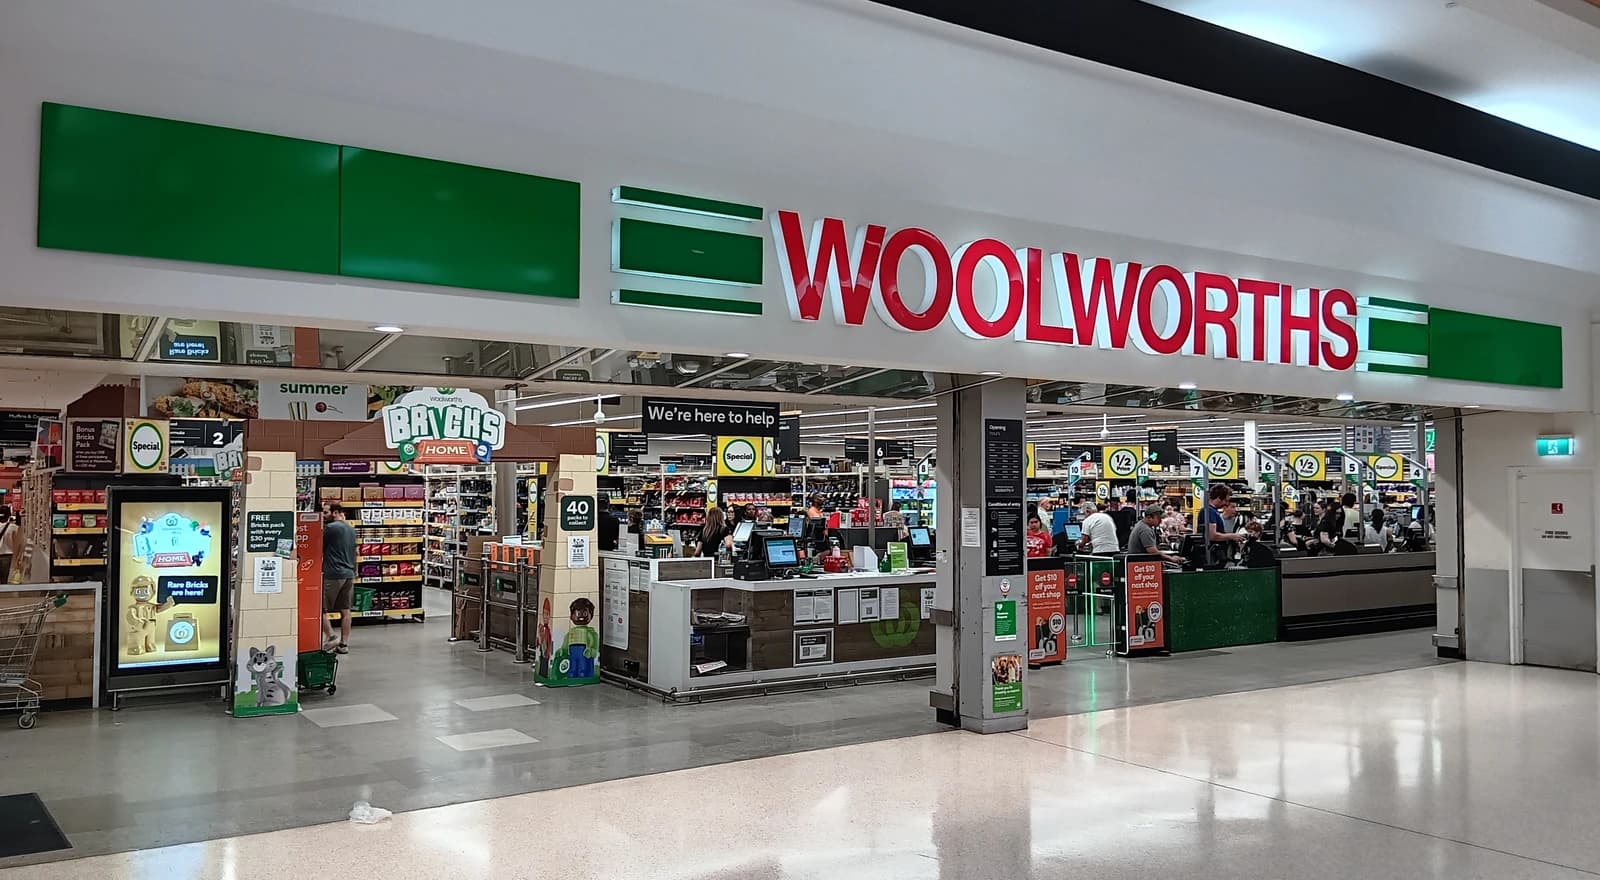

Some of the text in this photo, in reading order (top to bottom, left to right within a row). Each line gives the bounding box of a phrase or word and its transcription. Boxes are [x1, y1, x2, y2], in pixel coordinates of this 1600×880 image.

[776, 210, 1358, 370] WOOLWORTHS
[279, 382, 348, 395] summer
[647, 405, 691, 422] We're
[694, 408, 726, 423] here
[728, 410, 743, 424] to
[745, 410, 775, 429] help
[76, 425, 95, 433] Bonus
[389, 404, 500, 445] BRICKS
[213, 432, 224, 445] 2
[133, 441, 160, 453] Special
[425, 446, 468, 454] HOME
[726, 453, 752, 461] Special
[877, 448, 883, 457] 6
[1115, 454, 1131, 467] 1/2
[1212, 456, 1227, 468] 1/2
[1300, 459, 1314, 470] 1/2
[1071, 466, 1079, 474] 10
[1141, 467, 1146, 475] 11
[1193, 466, 1200, 476] 7
[1265, 462, 1272, 471] 6
[1349, 463, 1355, 472] 5
[1413, 469, 1420, 477] 4
[567, 501, 589, 515] 40
[1134, 565, 1145, 573] Get
[1034, 573, 1058, 582] Get $10
[1142, 574, 1155, 582] your
[167, 581, 209, 589] Rare Bricks
[1035, 583, 1057, 592] off your
[1145, 581, 1159, 589] shop
[184, 589, 205, 597] here!
[1046, 592, 1061, 600] shop
[1052, 618, 1062, 626] $10
